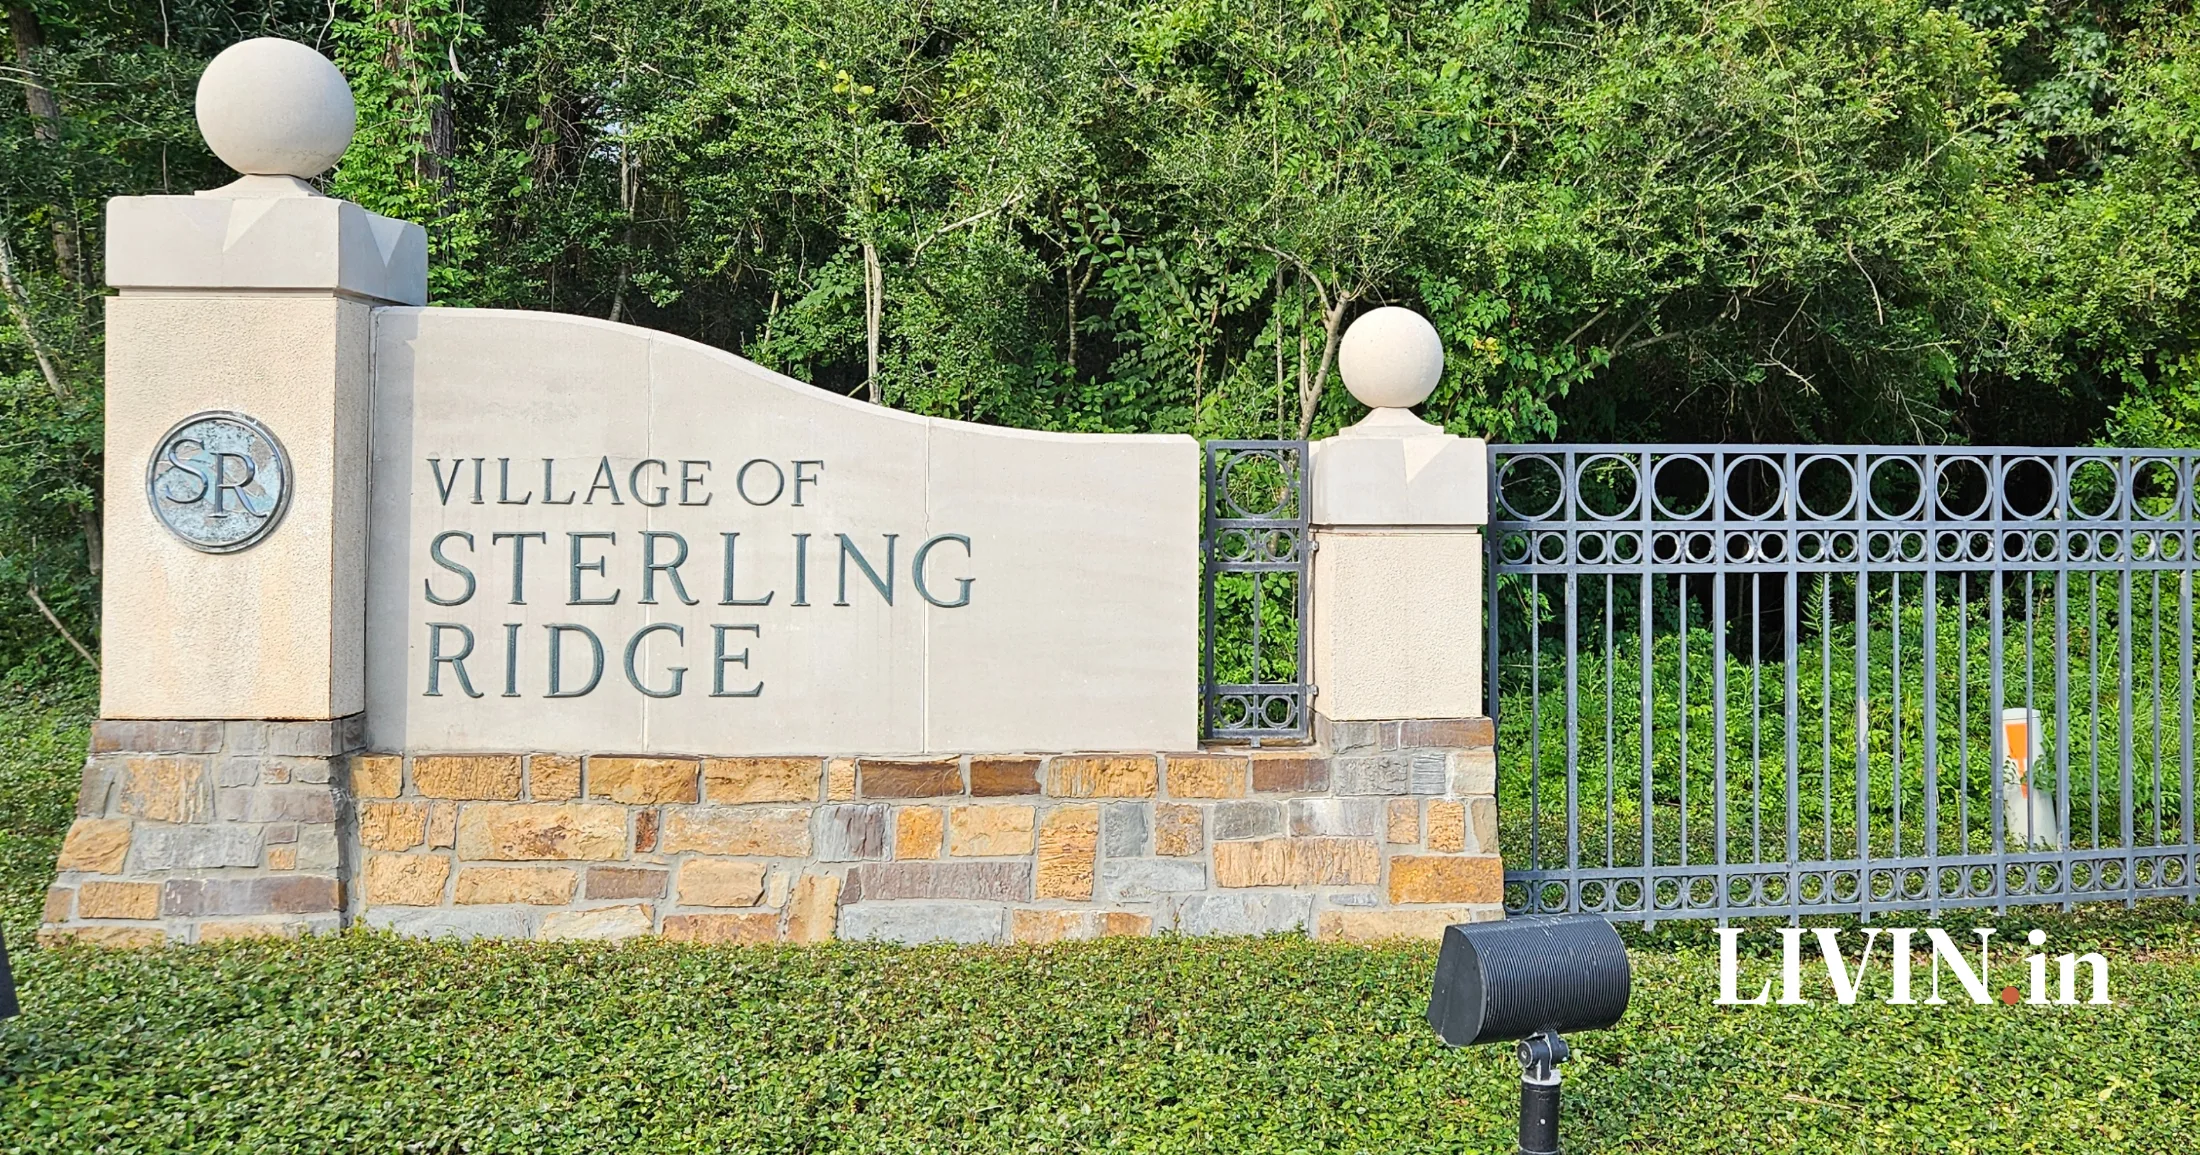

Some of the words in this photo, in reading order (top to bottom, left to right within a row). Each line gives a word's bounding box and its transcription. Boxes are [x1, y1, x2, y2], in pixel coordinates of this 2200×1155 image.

[166, 438, 269, 518] SR
[426, 456, 713, 507] VILLAGE
[736, 459, 824, 506] OF
[424, 529, 976, 609] STERLING
[422, 622, 764, 699] RIDGE
